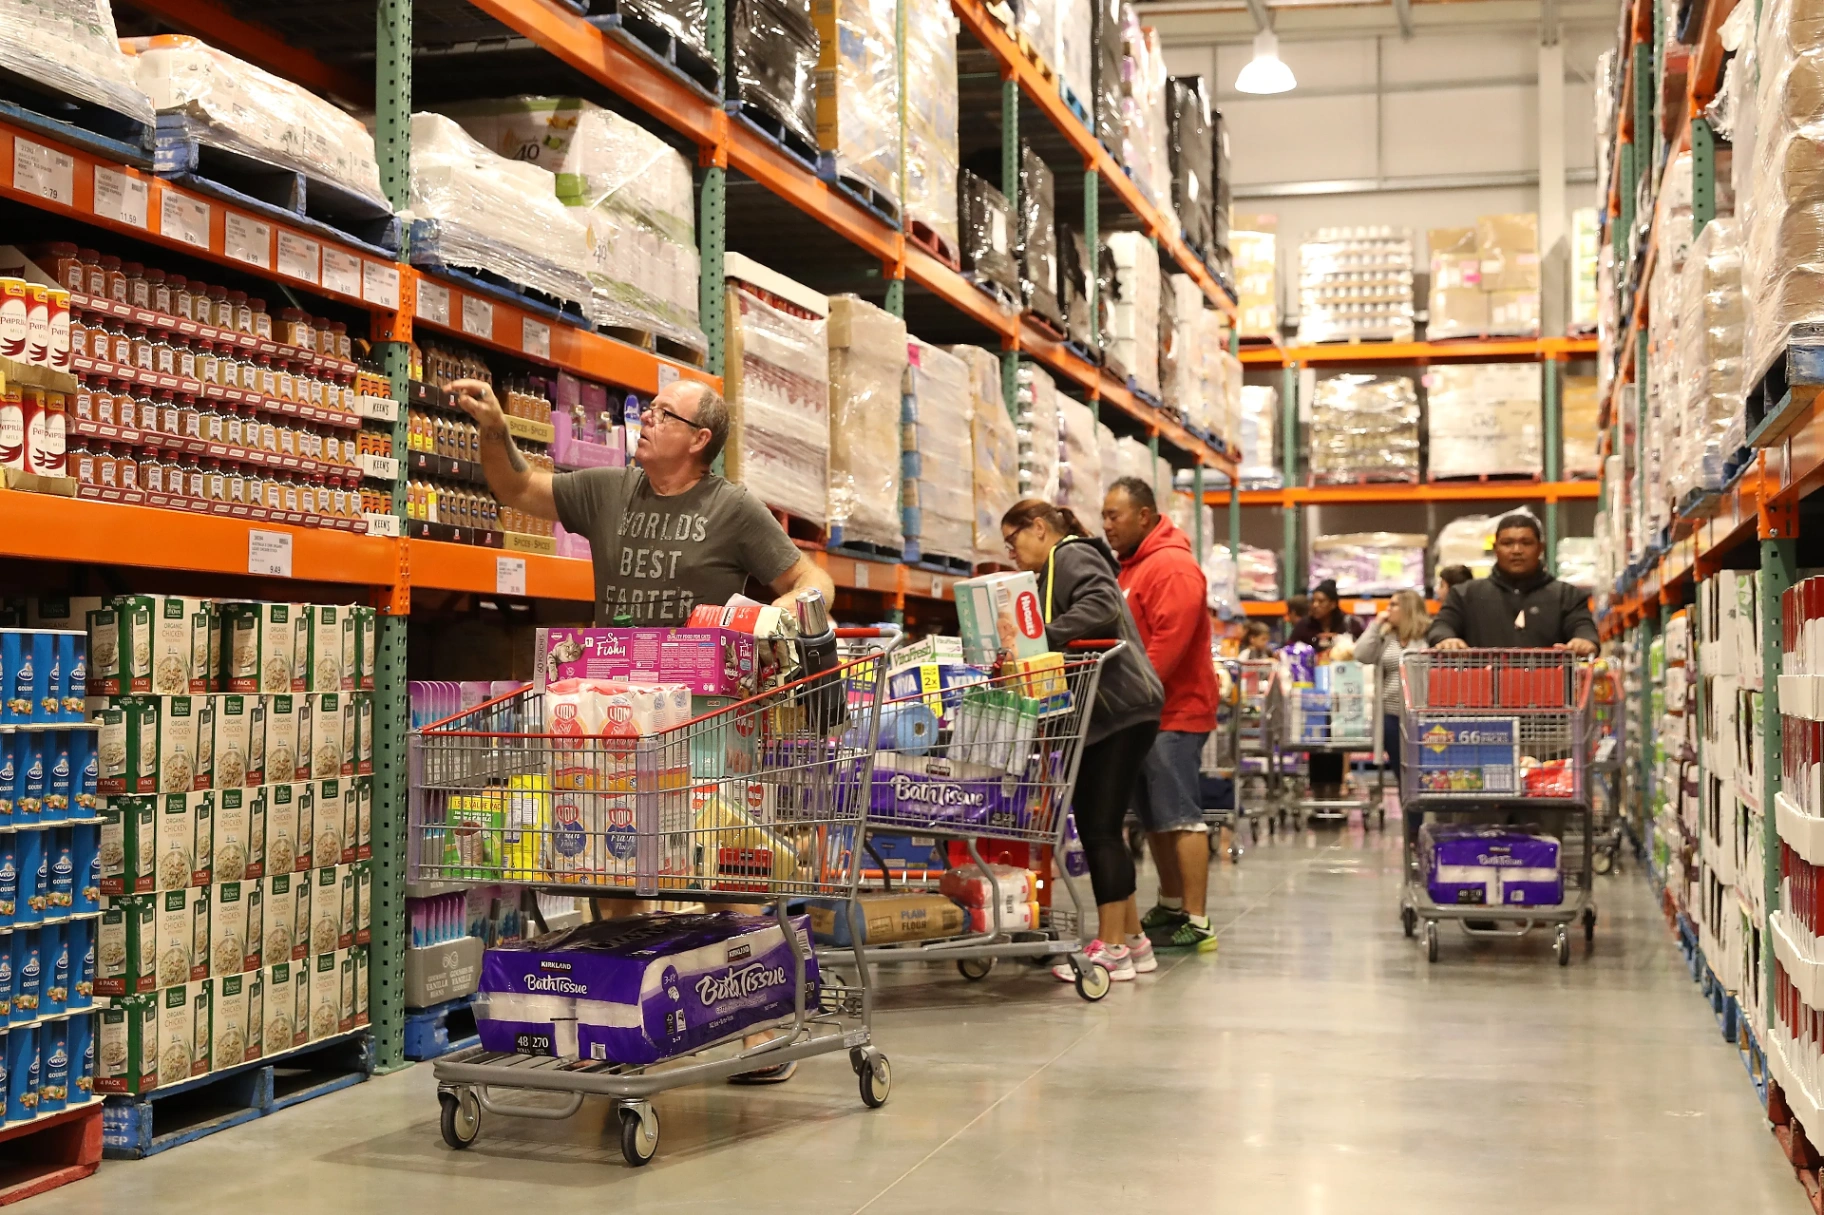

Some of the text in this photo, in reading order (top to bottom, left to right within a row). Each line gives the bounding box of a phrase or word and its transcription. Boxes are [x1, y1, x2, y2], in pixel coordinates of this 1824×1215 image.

[372, 402, 390, 416] KEEN'S
[372, 460, 390, 473] KEEN'S
[374, 519, 390, 532] KEEN'S
[617, 507, 708, 542] WORLD'S
[620, 546, 682, 579] BEST
[605, 584, 694, 620] FARTER
[1020, 595, 1036, 637] HUGGIES
[164, 622, 183, 630] ORGANIC
[162, 630, 184, 638] CHICKEN
[596, 642, 626, 656] Fishy
[892, 642, 932, 666] VitaFresh
[892, 675, 918, 697] VIVA
[924, 676, 938, 686] 2x
[556, 704, 575, 720] LION
[608, 706, 630, 722] LION
[1458, 730, 1481, 744] 66
[610, 810, 632, 826] LON
[164, 825, 187, 833] CHICKEN
[220, 820, 243, 828] CHICKEN
[318, 895, 336, 903] CHICKEN
[220, 904, 240, 912] ORGANIC
[270, 904, 290, 912] CHICKEN
[165, 914, 185, 922] ORGANIC
[218, 912, 241, 920] CHICKEN
[901, 908, 926, 920] PLAIN
[164, 922, 186, 930] CHICKEN
[901, 920, 928, 931] FLOUR
[728, 946, 750, 958] KIRKLAND
[540, 960, 572, 970] KIRKLAND
[316, 980, 335, 988] CHICKEN
[452, 974, 472, 985] VANILLE
[272, 986, 288, 994] ORGANIC
[426, 980, 448, 991] VANILLA
[270, 992, 290, 1001] CHICKEN
[430, 989, 444, 998] BEANS
[166, 1010, 186, 1018] ORGANIC
[220, 1006, 242, 1016] CHICKEN
[164, 1018, 188, 1028] CHICKEN
[517, 1036, 528, 1046] 48
[532, 1036, 549, 1048] 270
